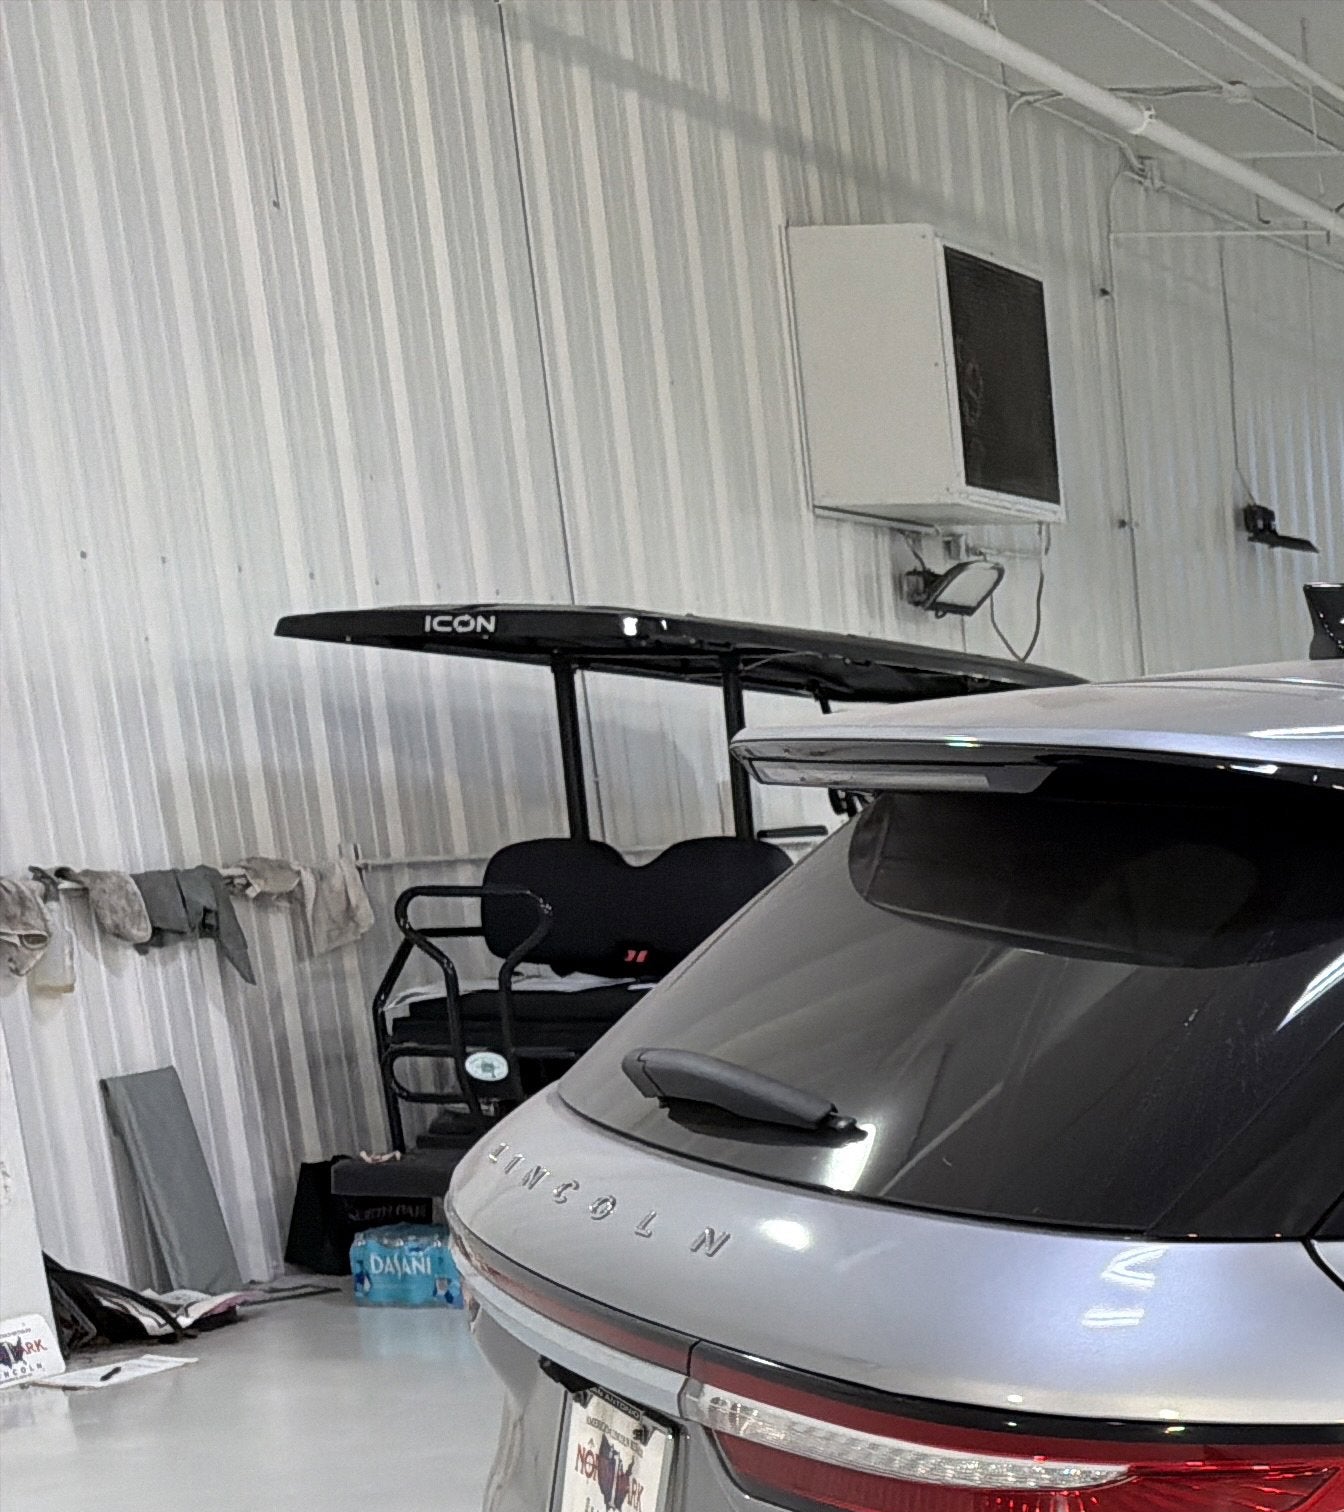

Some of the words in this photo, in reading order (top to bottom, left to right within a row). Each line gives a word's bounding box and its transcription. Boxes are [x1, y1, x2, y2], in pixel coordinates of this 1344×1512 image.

[424, 614, 496, 633] ICON
[488, 1141, 732, 1258] LINCOLN
[369, 1251, 432, 1280] DASANI
